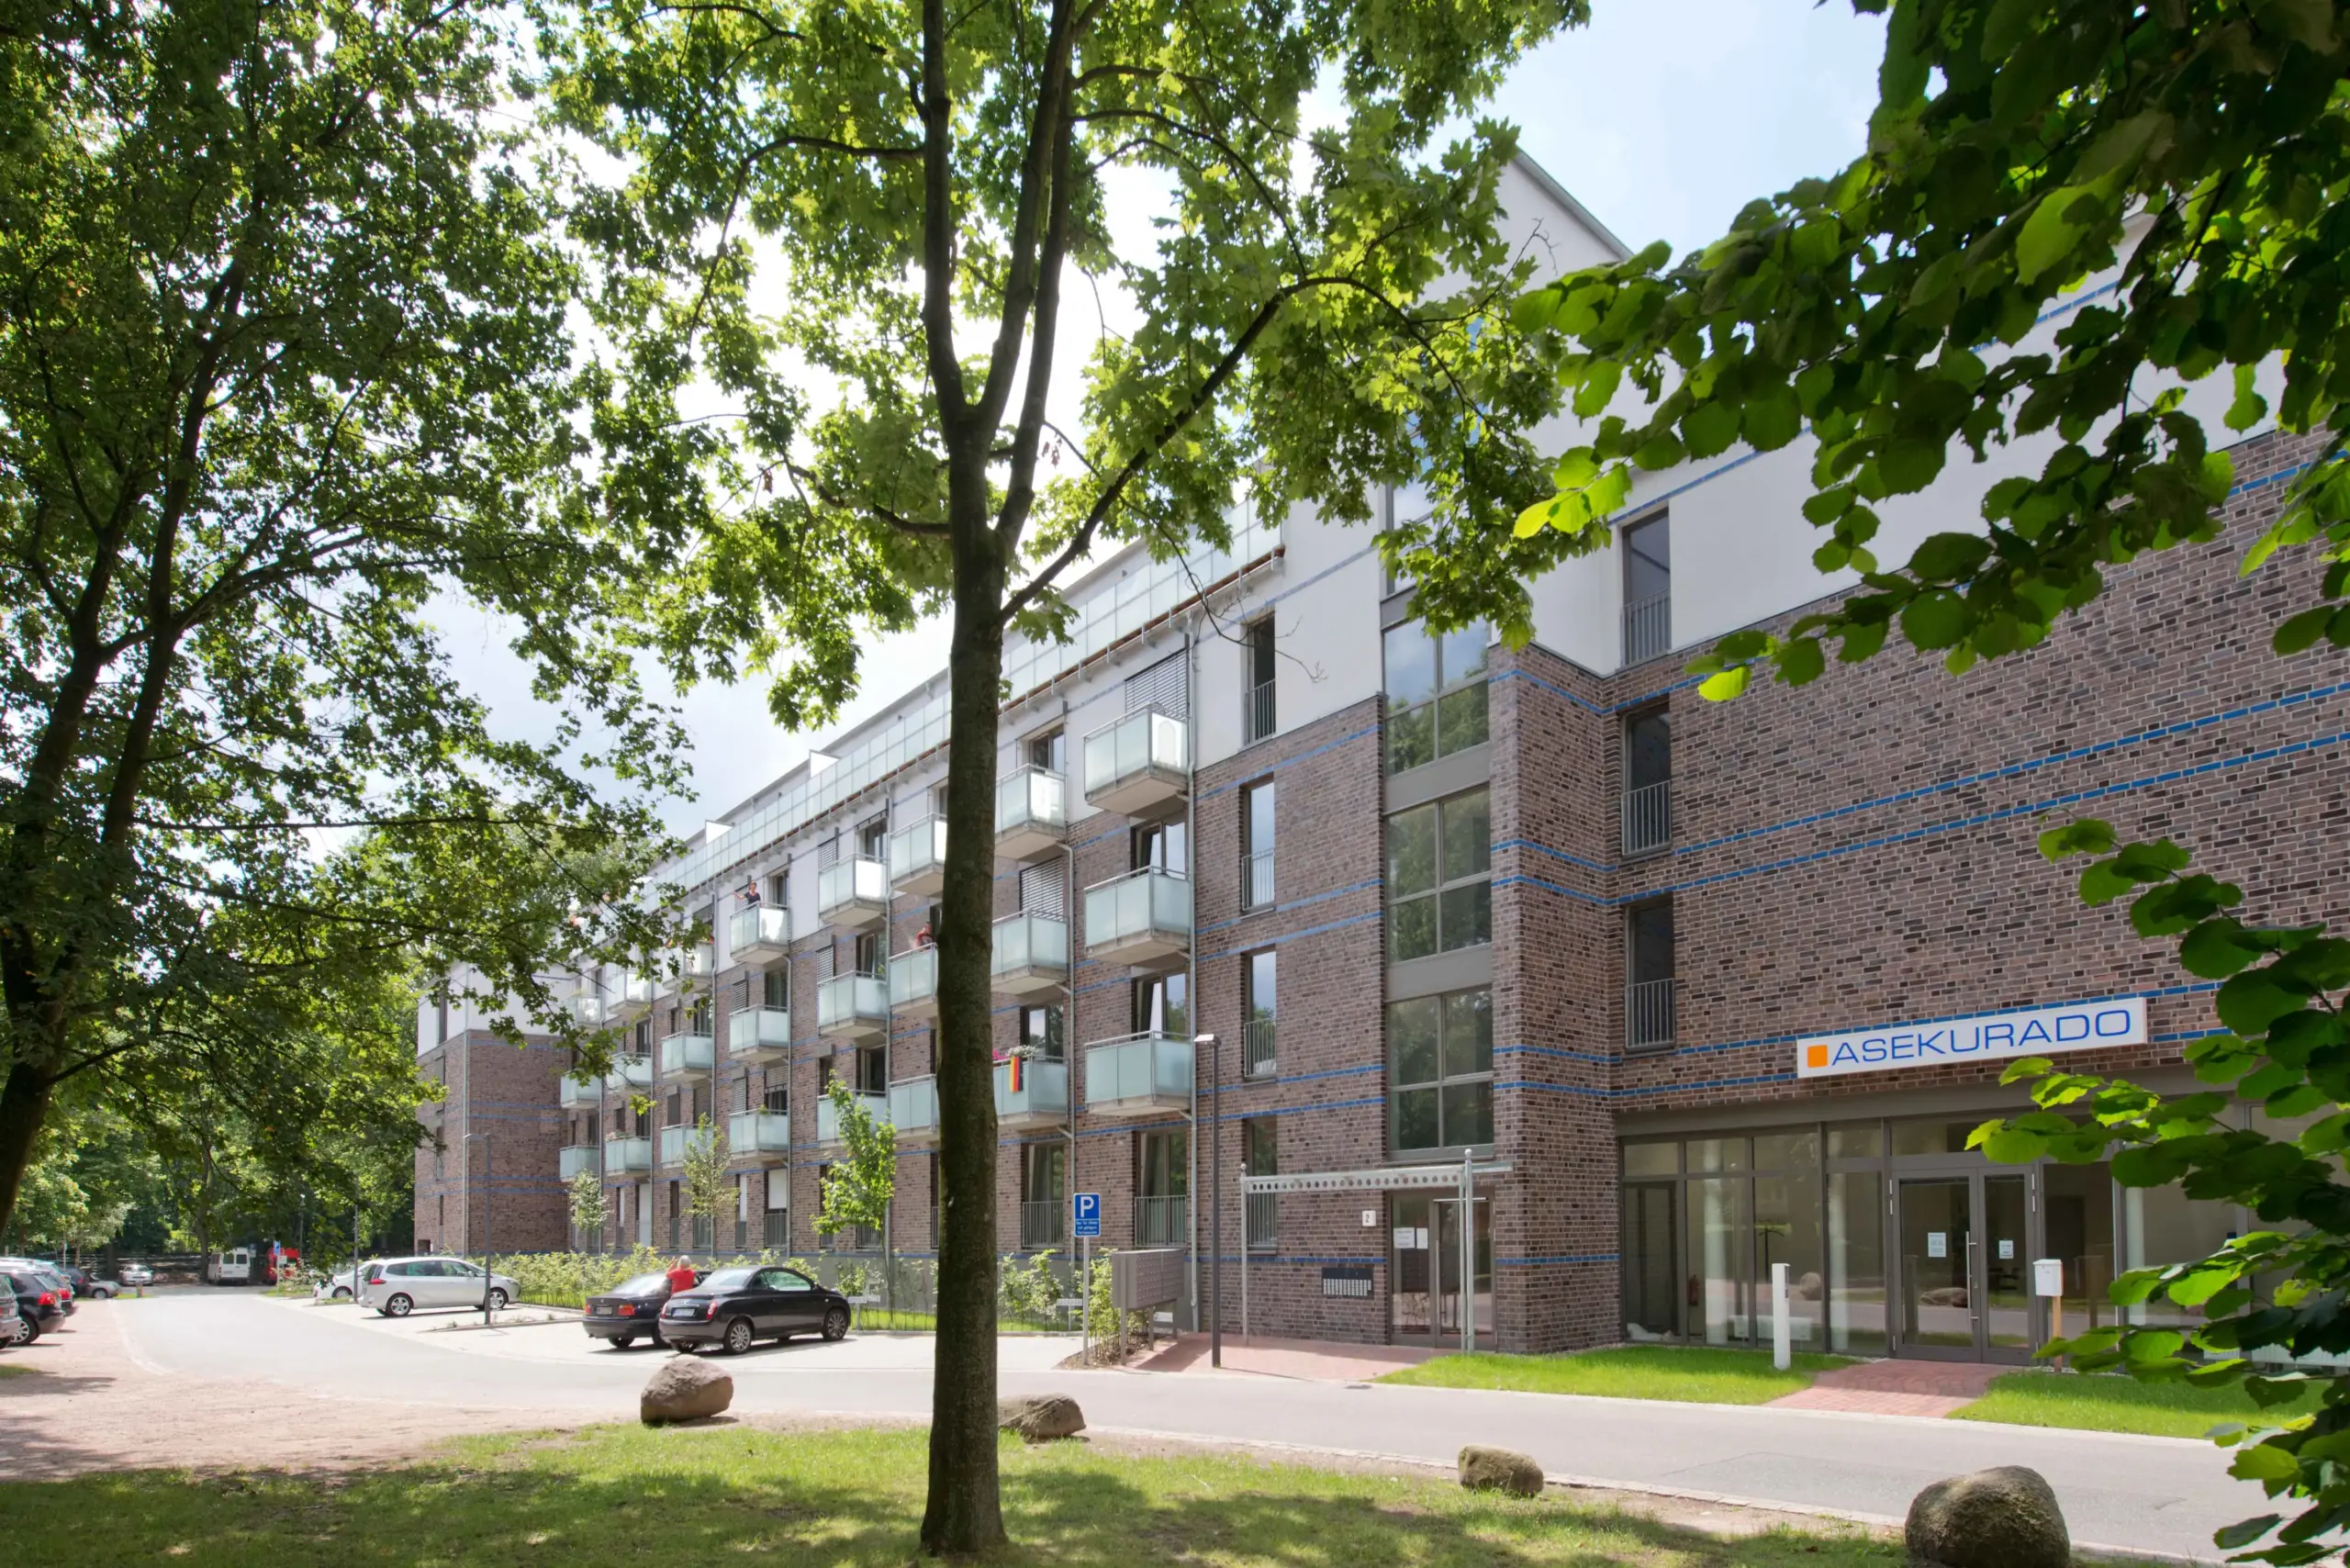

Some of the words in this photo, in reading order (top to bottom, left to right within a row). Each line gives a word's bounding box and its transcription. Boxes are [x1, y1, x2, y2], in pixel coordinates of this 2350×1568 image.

[1831, 1009, 2131, 1066] ASEKURADO
[1080, 1196, 1094, 1218] P
[1365, 1214, 1370, 1223] 2
